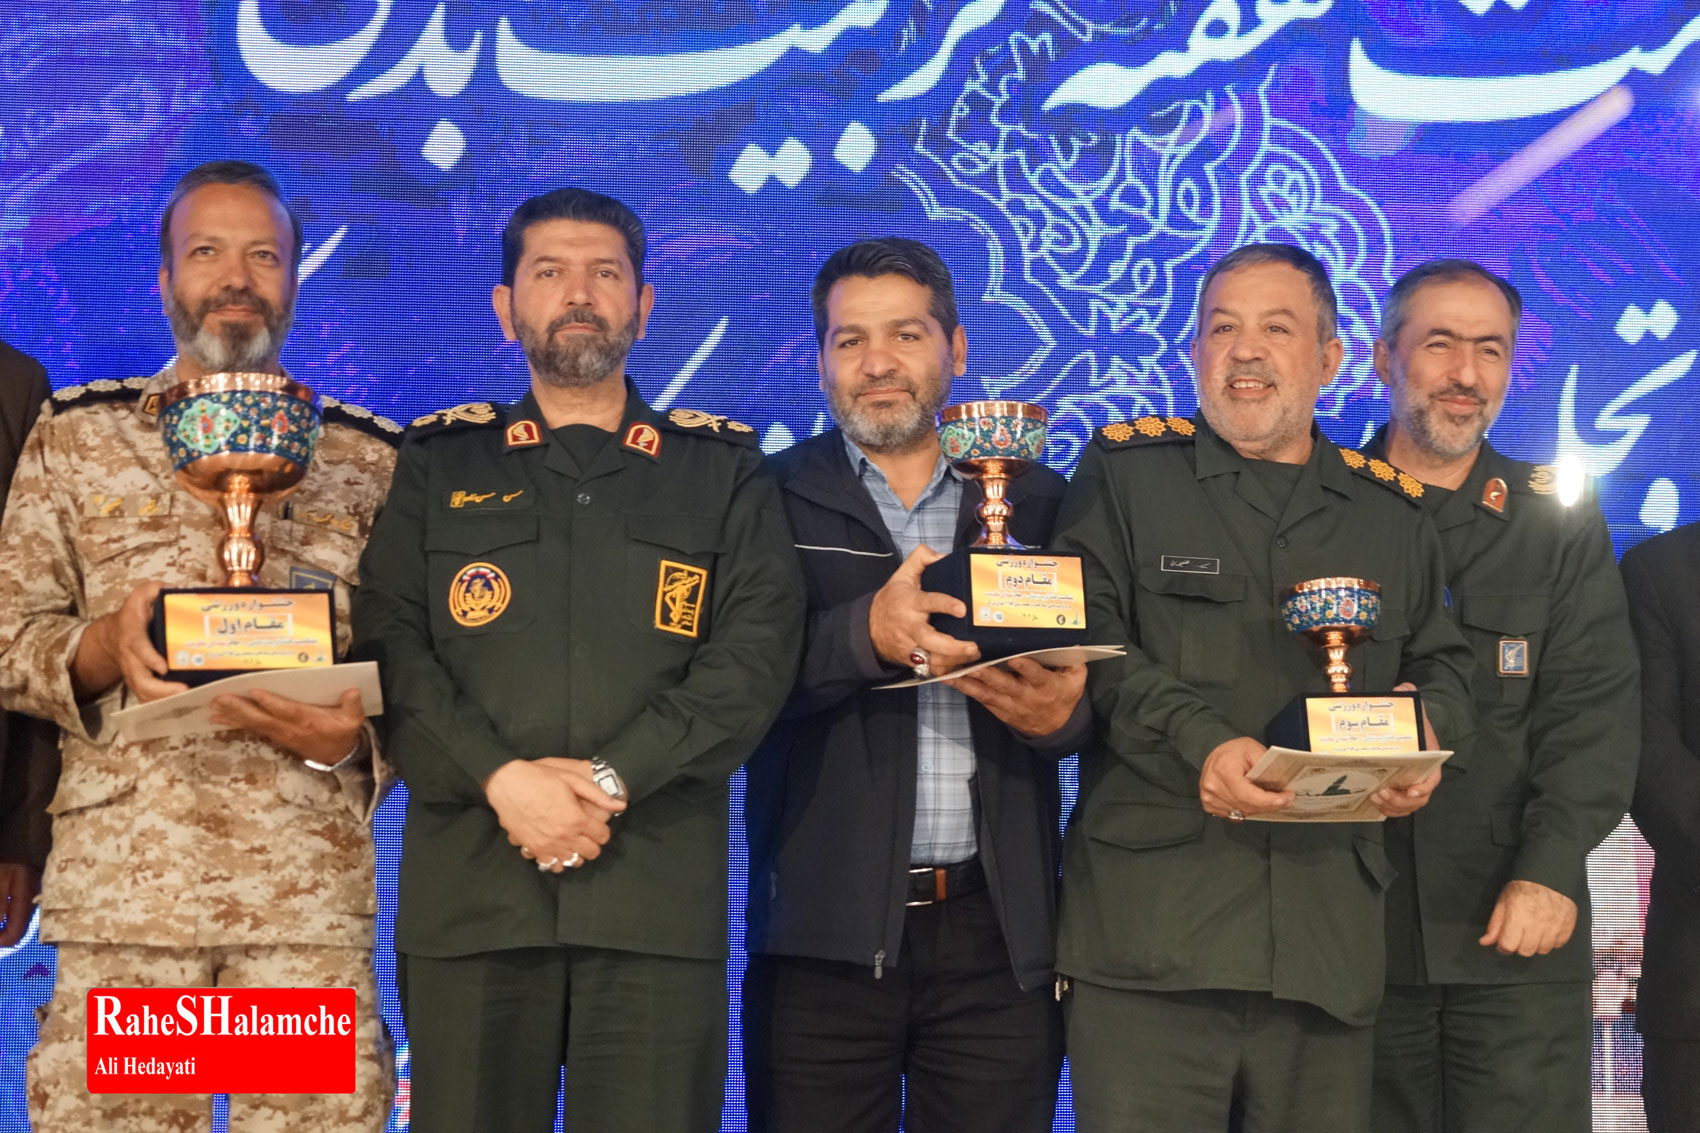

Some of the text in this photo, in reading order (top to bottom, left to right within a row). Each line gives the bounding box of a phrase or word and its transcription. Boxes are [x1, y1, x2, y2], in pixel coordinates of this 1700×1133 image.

[1005, 573, 1053, 587] مقام دوم
[217, 617, 284, 634] مقام اول
[1339, 715, 1390, 731] مقام سوم
